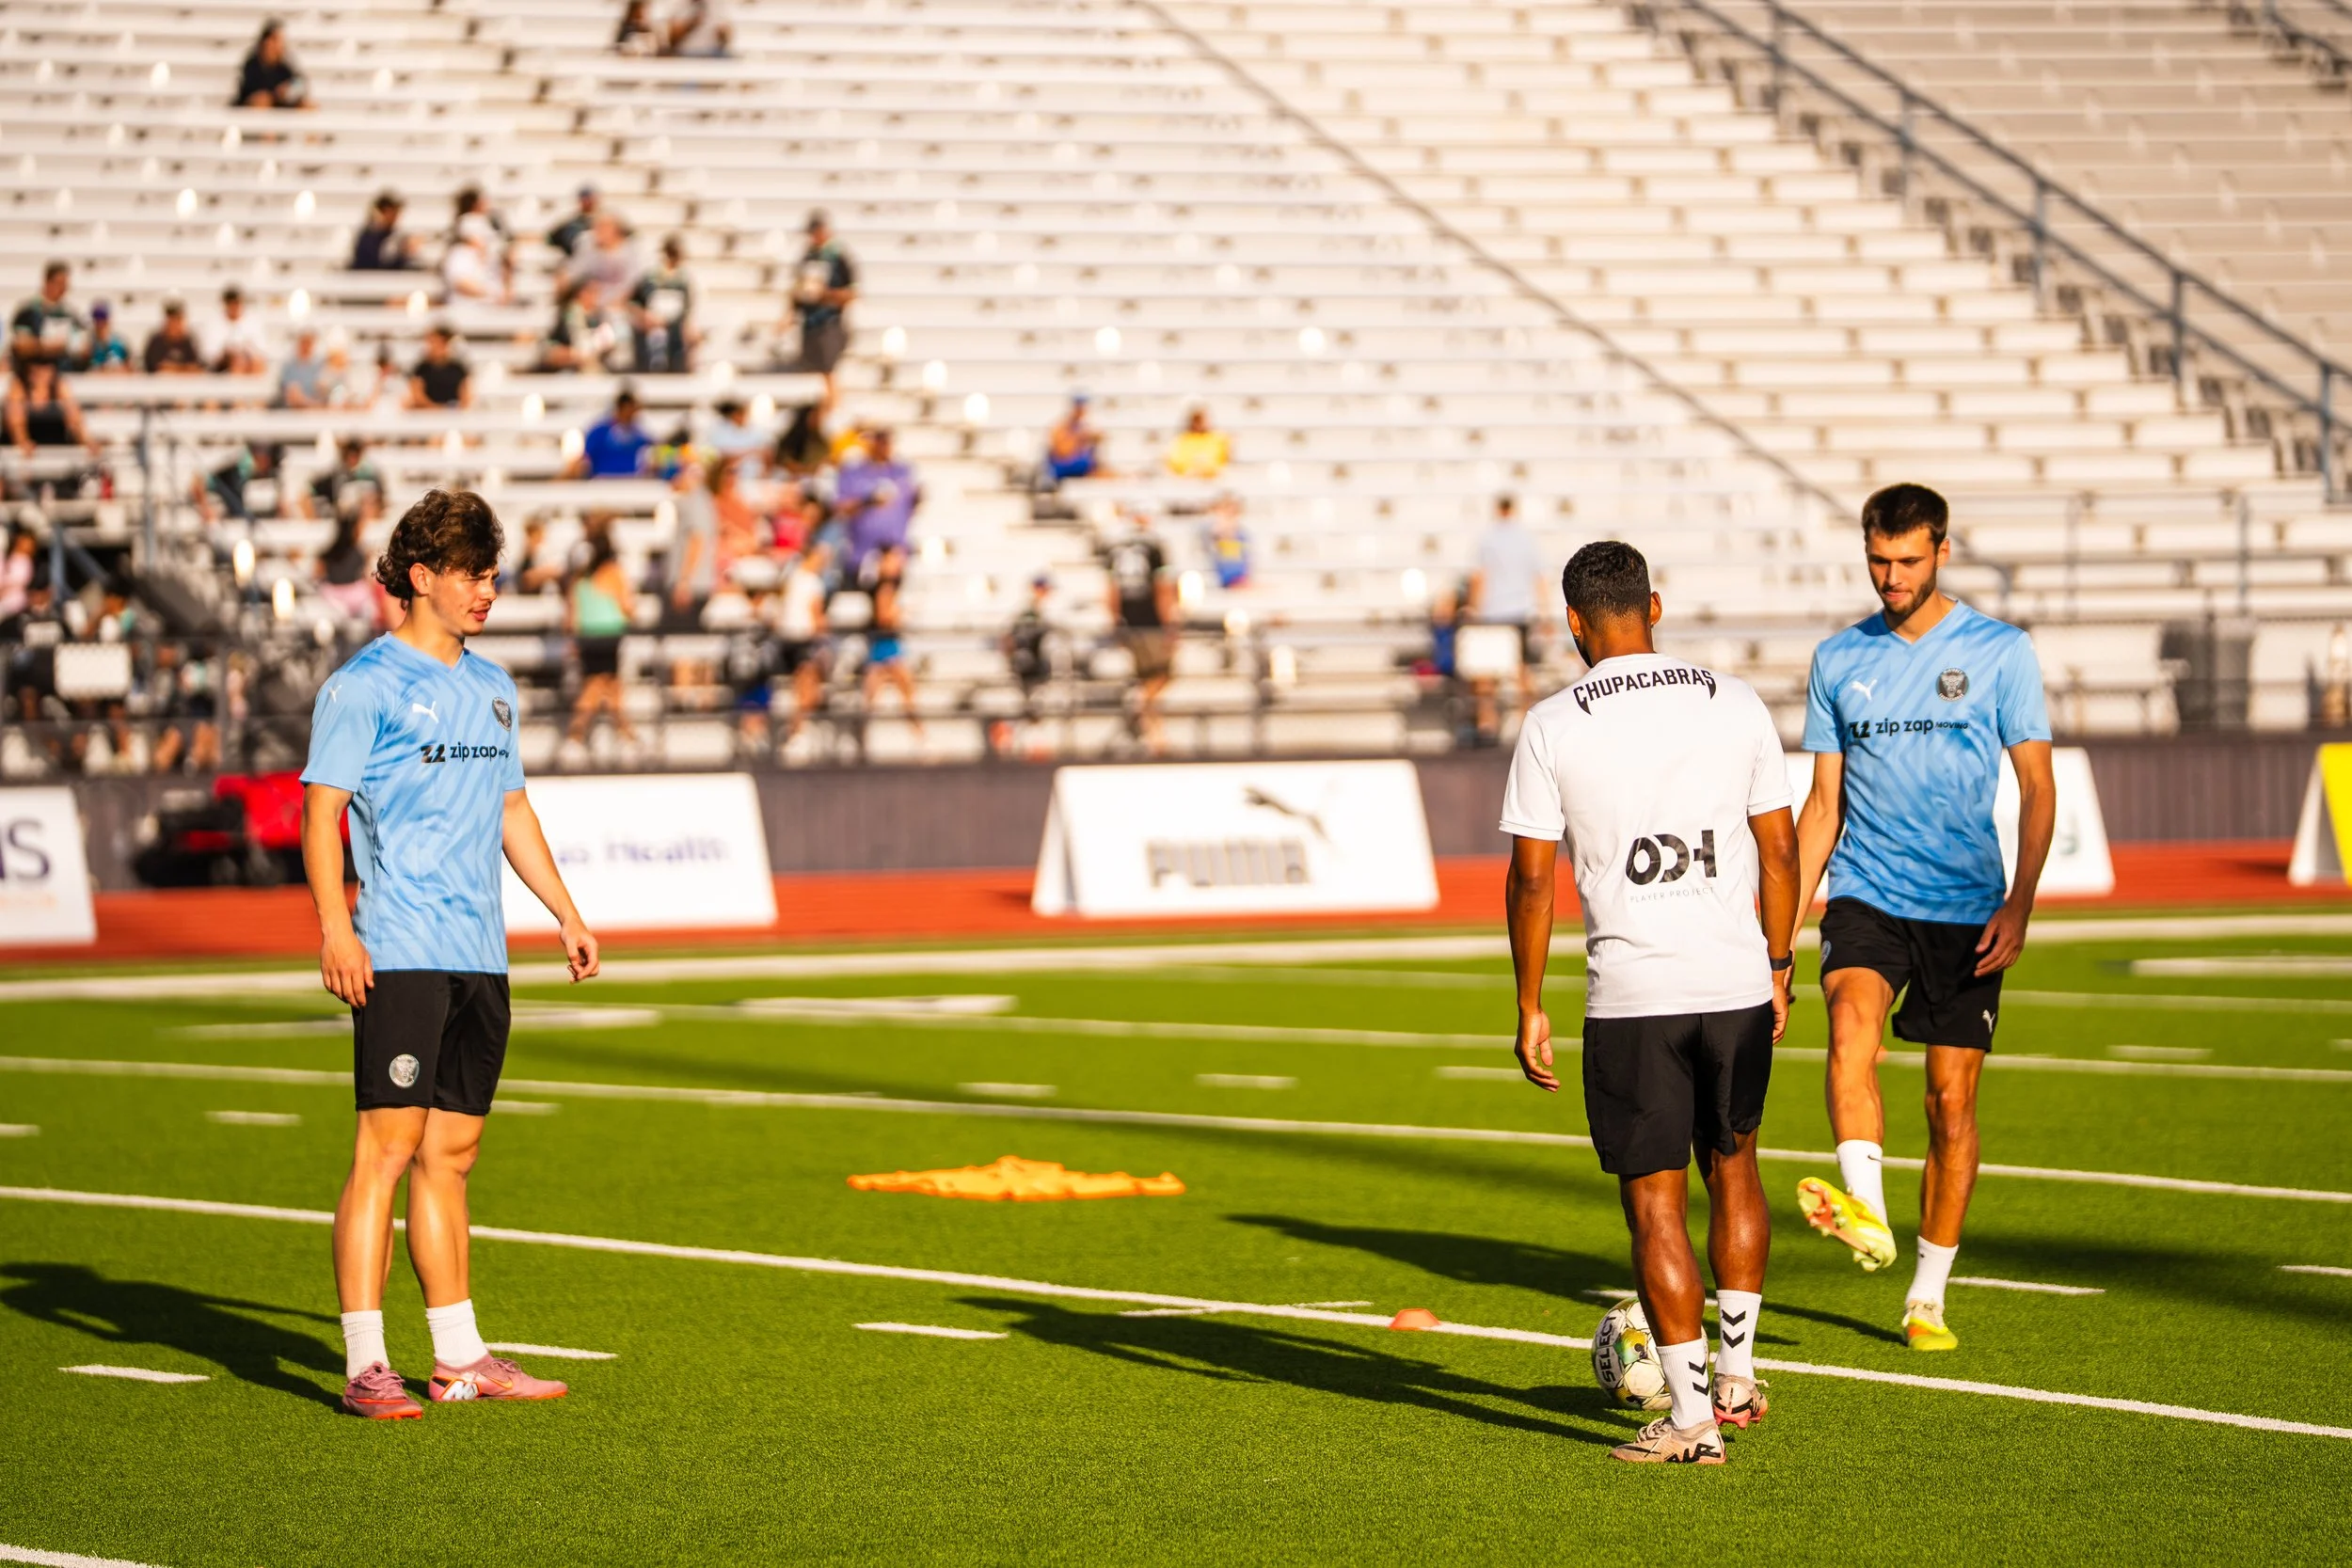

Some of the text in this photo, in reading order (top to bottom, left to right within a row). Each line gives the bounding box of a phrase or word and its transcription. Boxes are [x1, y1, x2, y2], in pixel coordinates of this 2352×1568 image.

[1573, 669, 1717, 716] CHUPACABRAS
[1875, 718, 1899, 736] zip
[1903, 719, 1933, 735] zap
[1935, 721, 1969, 730] MOVING
[450, 741, 469, 762] zip
[471, 745, 498, 762] zap
[1629, 886, 1715, 903] PLAYER PROJECT
[1598, 1315, 1617, 1383] SELECT
